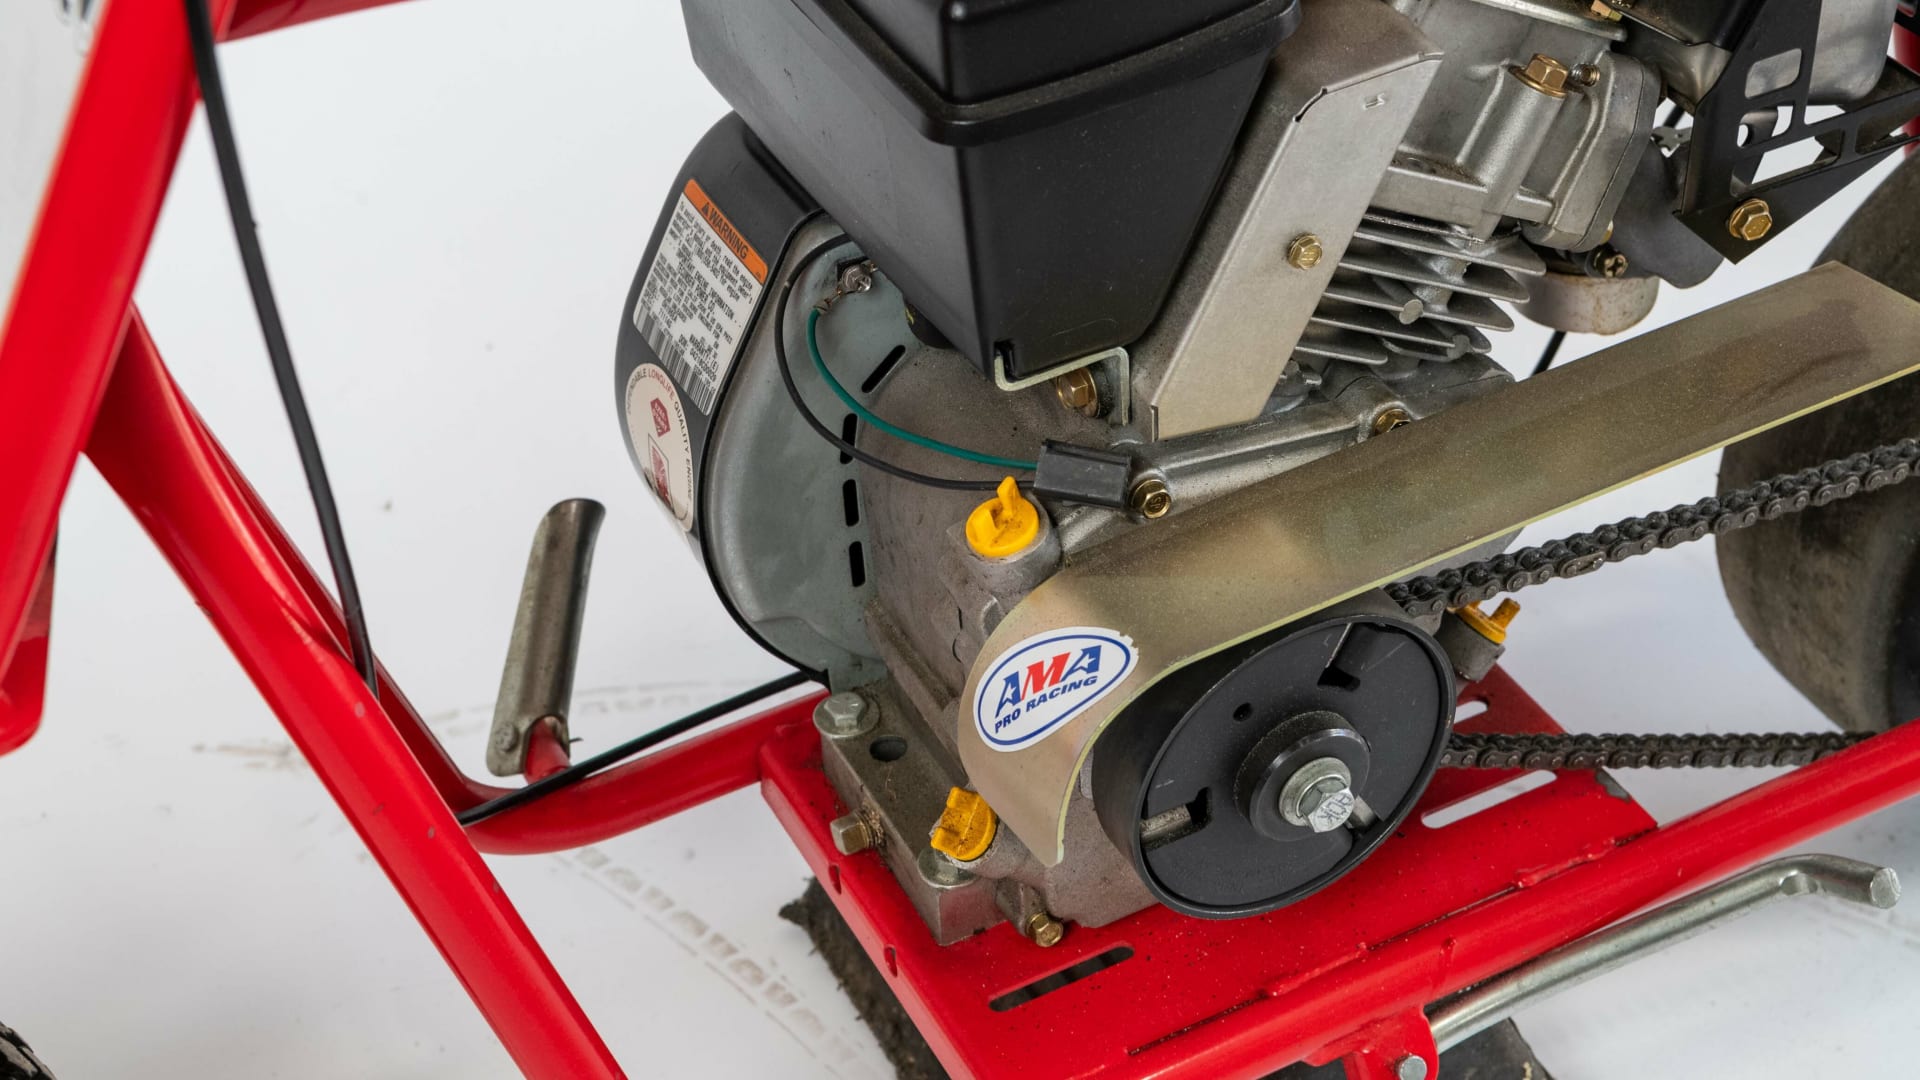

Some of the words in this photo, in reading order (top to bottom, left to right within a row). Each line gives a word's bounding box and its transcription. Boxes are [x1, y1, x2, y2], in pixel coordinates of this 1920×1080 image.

[708, 210, 748, 260] WARNING
[694, 283, 708, 305] POWER
[694, 269, 708, 291] ENGINE
[708, 286, 734, 321] INFORMATION
[648, 368, 676, 401] LONGLIFE
[674, 401, 690, 454] QUALITY
[994, 708, 1021, 735] PRO
[1026, 675, 1099, 713] RACING
[995, 644, 1103, 719] AMA
